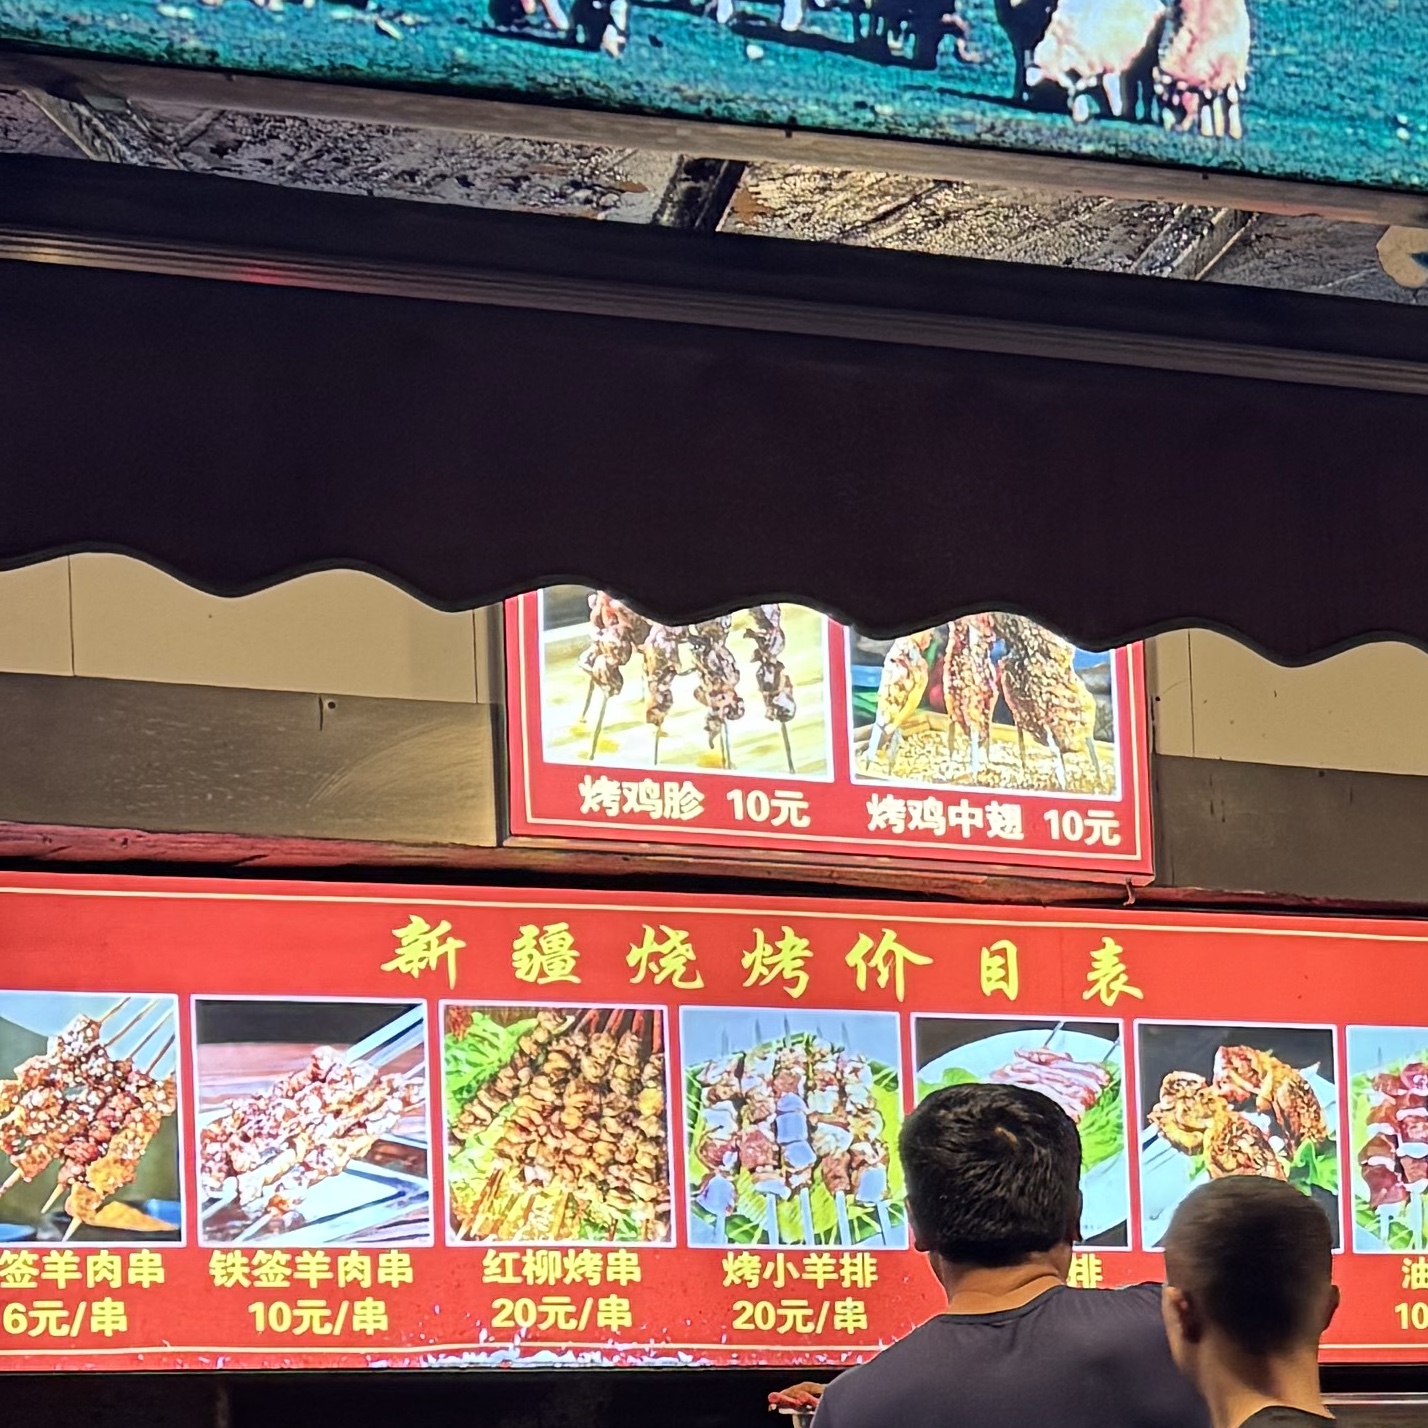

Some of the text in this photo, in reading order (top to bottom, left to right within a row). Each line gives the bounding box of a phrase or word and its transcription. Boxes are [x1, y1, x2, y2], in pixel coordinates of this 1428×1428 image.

[578, 774, 811, 828] 烤鸡胗 10元
[866, 793, 1122, 847] 烤鸡中翅 10元
[380, 914, 1144, 1007] 新疆烧烤价目表
[209, 1248, 414, 1290] 铁签羊肉串
[482, 1248, 642, 1288] 红柳烤串
[721, 1251, 879, 1290] 烤小羊排
[2, 1296, 129, 1338] 6元/串
[247, 1295, 390, 1338] 10元/串
[490, 1294, 633, 1331] 20元/串
[731, 1297, 869, 1335] 20元/串
